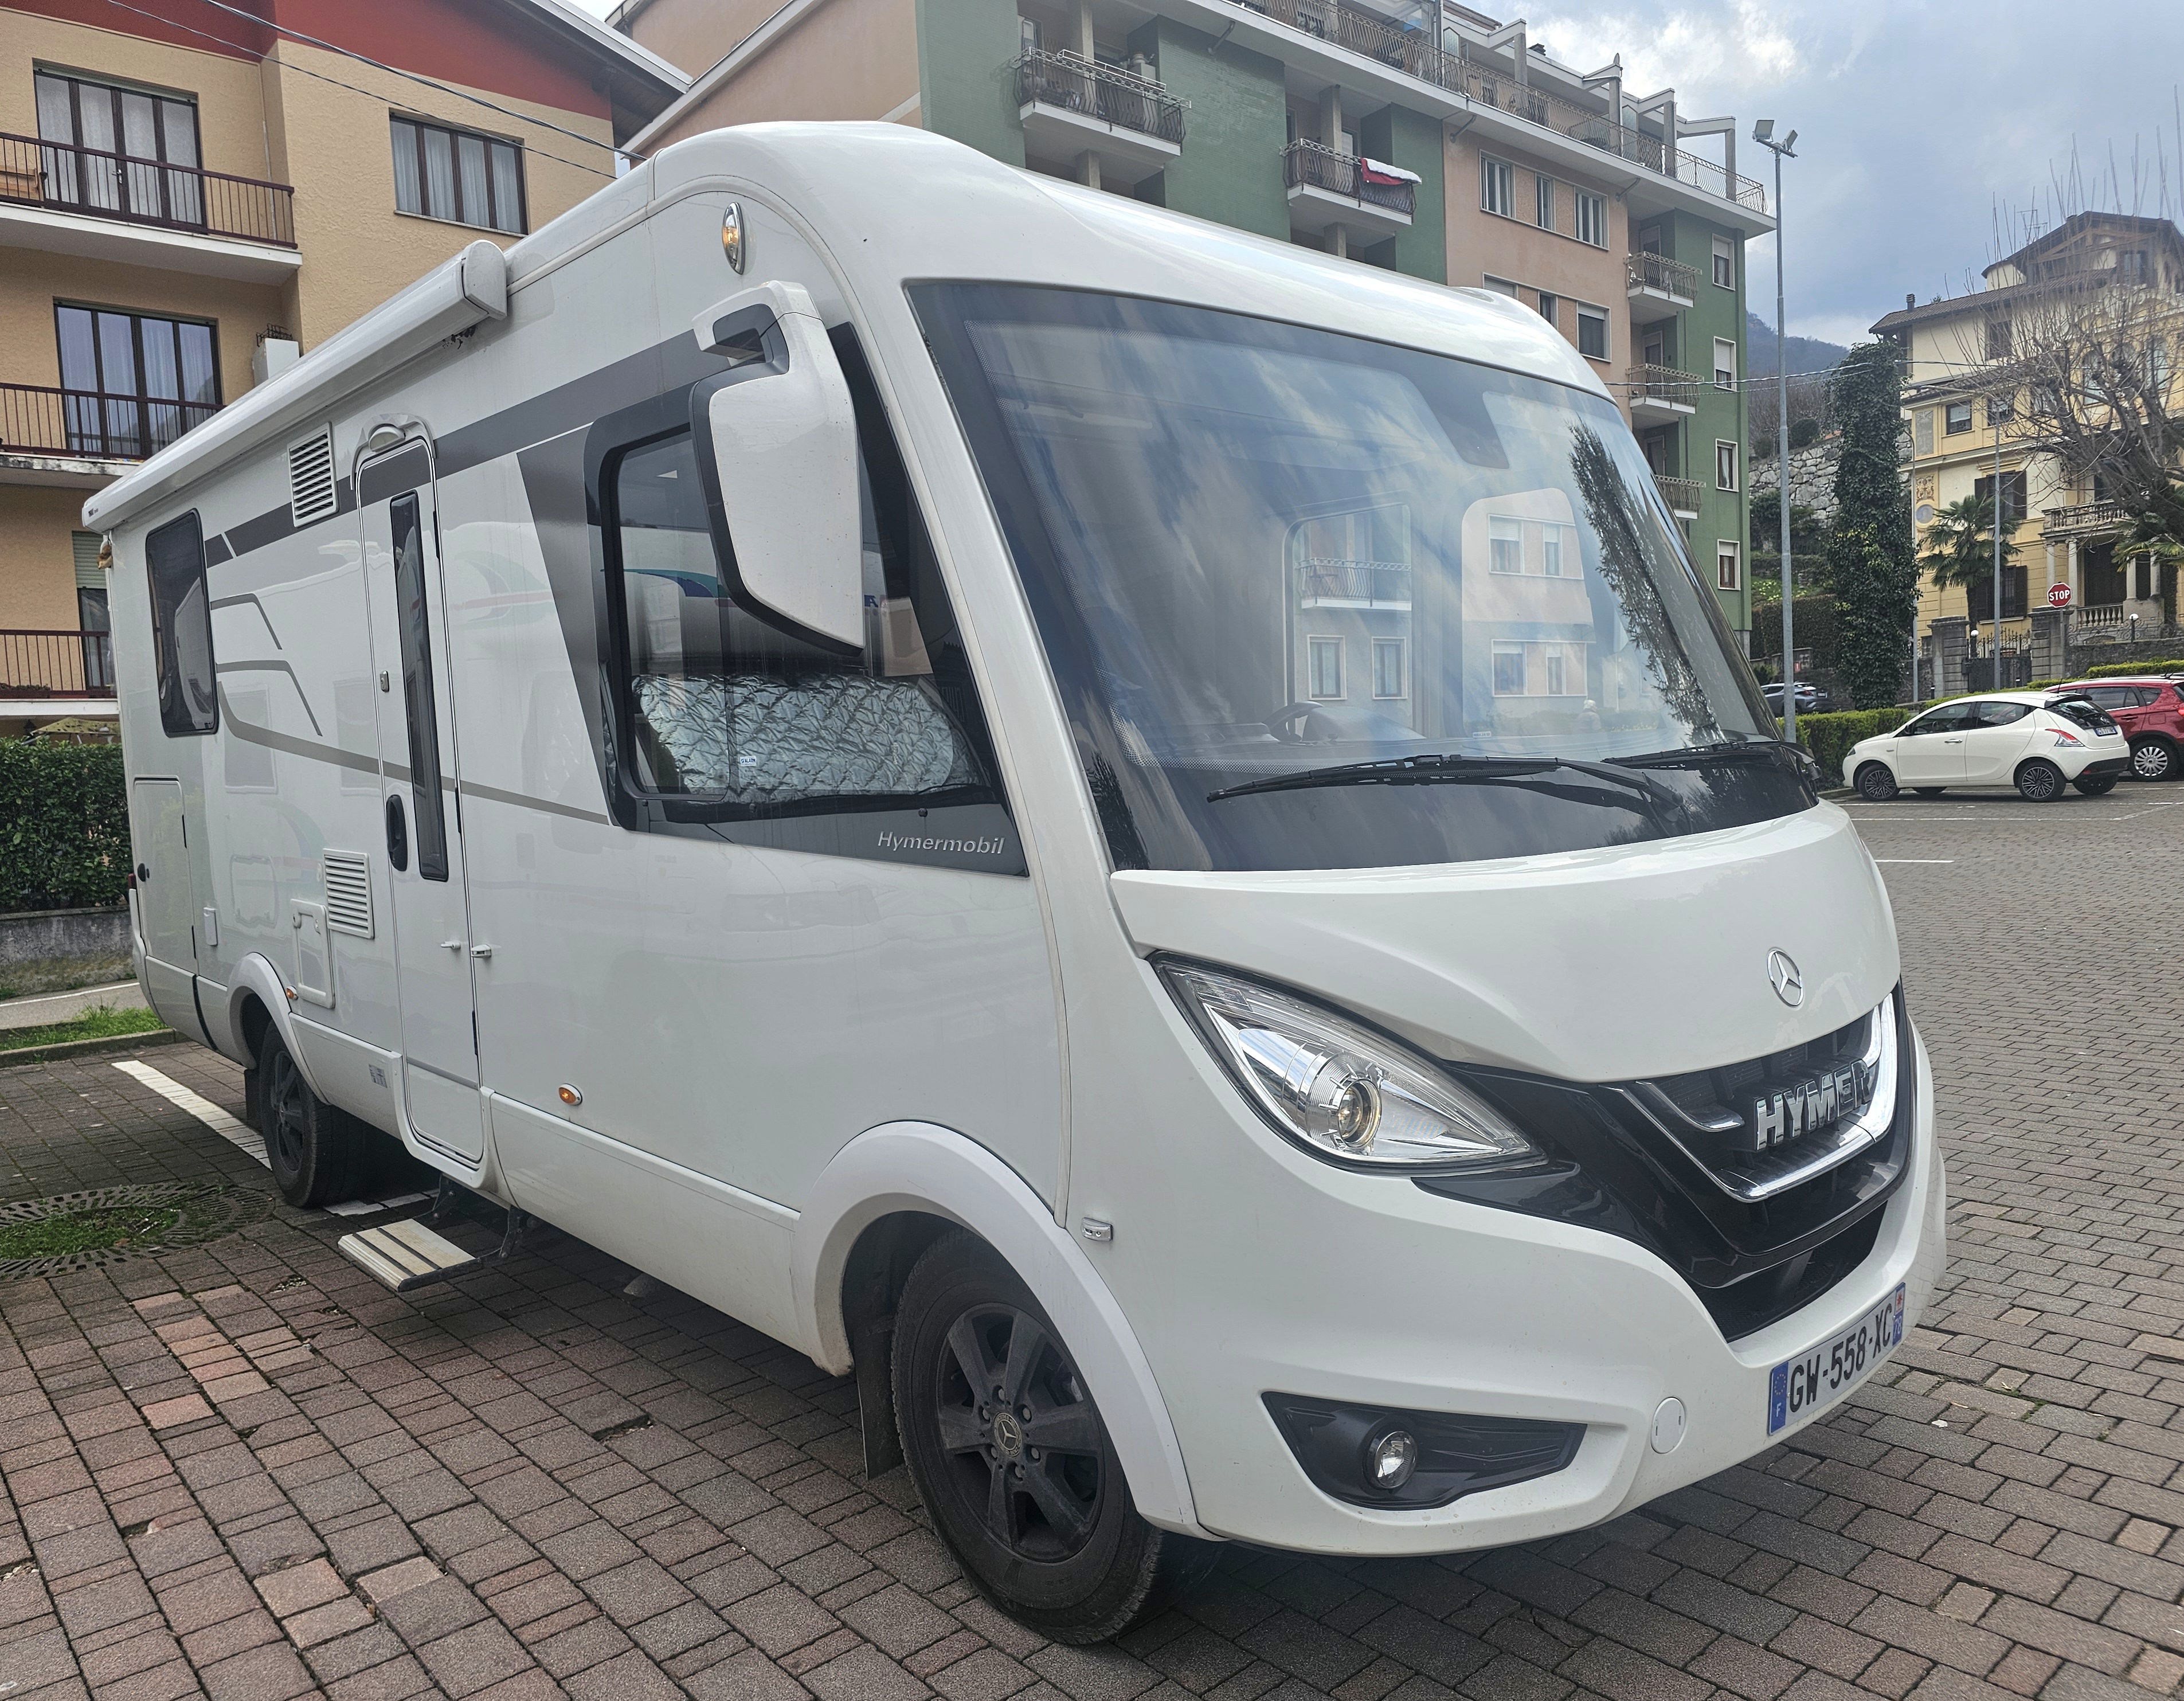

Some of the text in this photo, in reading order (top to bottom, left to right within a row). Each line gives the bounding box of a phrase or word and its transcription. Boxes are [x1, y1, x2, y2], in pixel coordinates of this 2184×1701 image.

[2049, 589, 2070, 601] STOP
[878, 831, 1005, 854] Hymermobil
[1755, 1059, 1870, 1151] HYMER
[1893, 1315, 1902, 1339] 78
[1789, 1303, 1892, 1413] GW-558-XC
[1776, 1402, 1782, 1418] F
